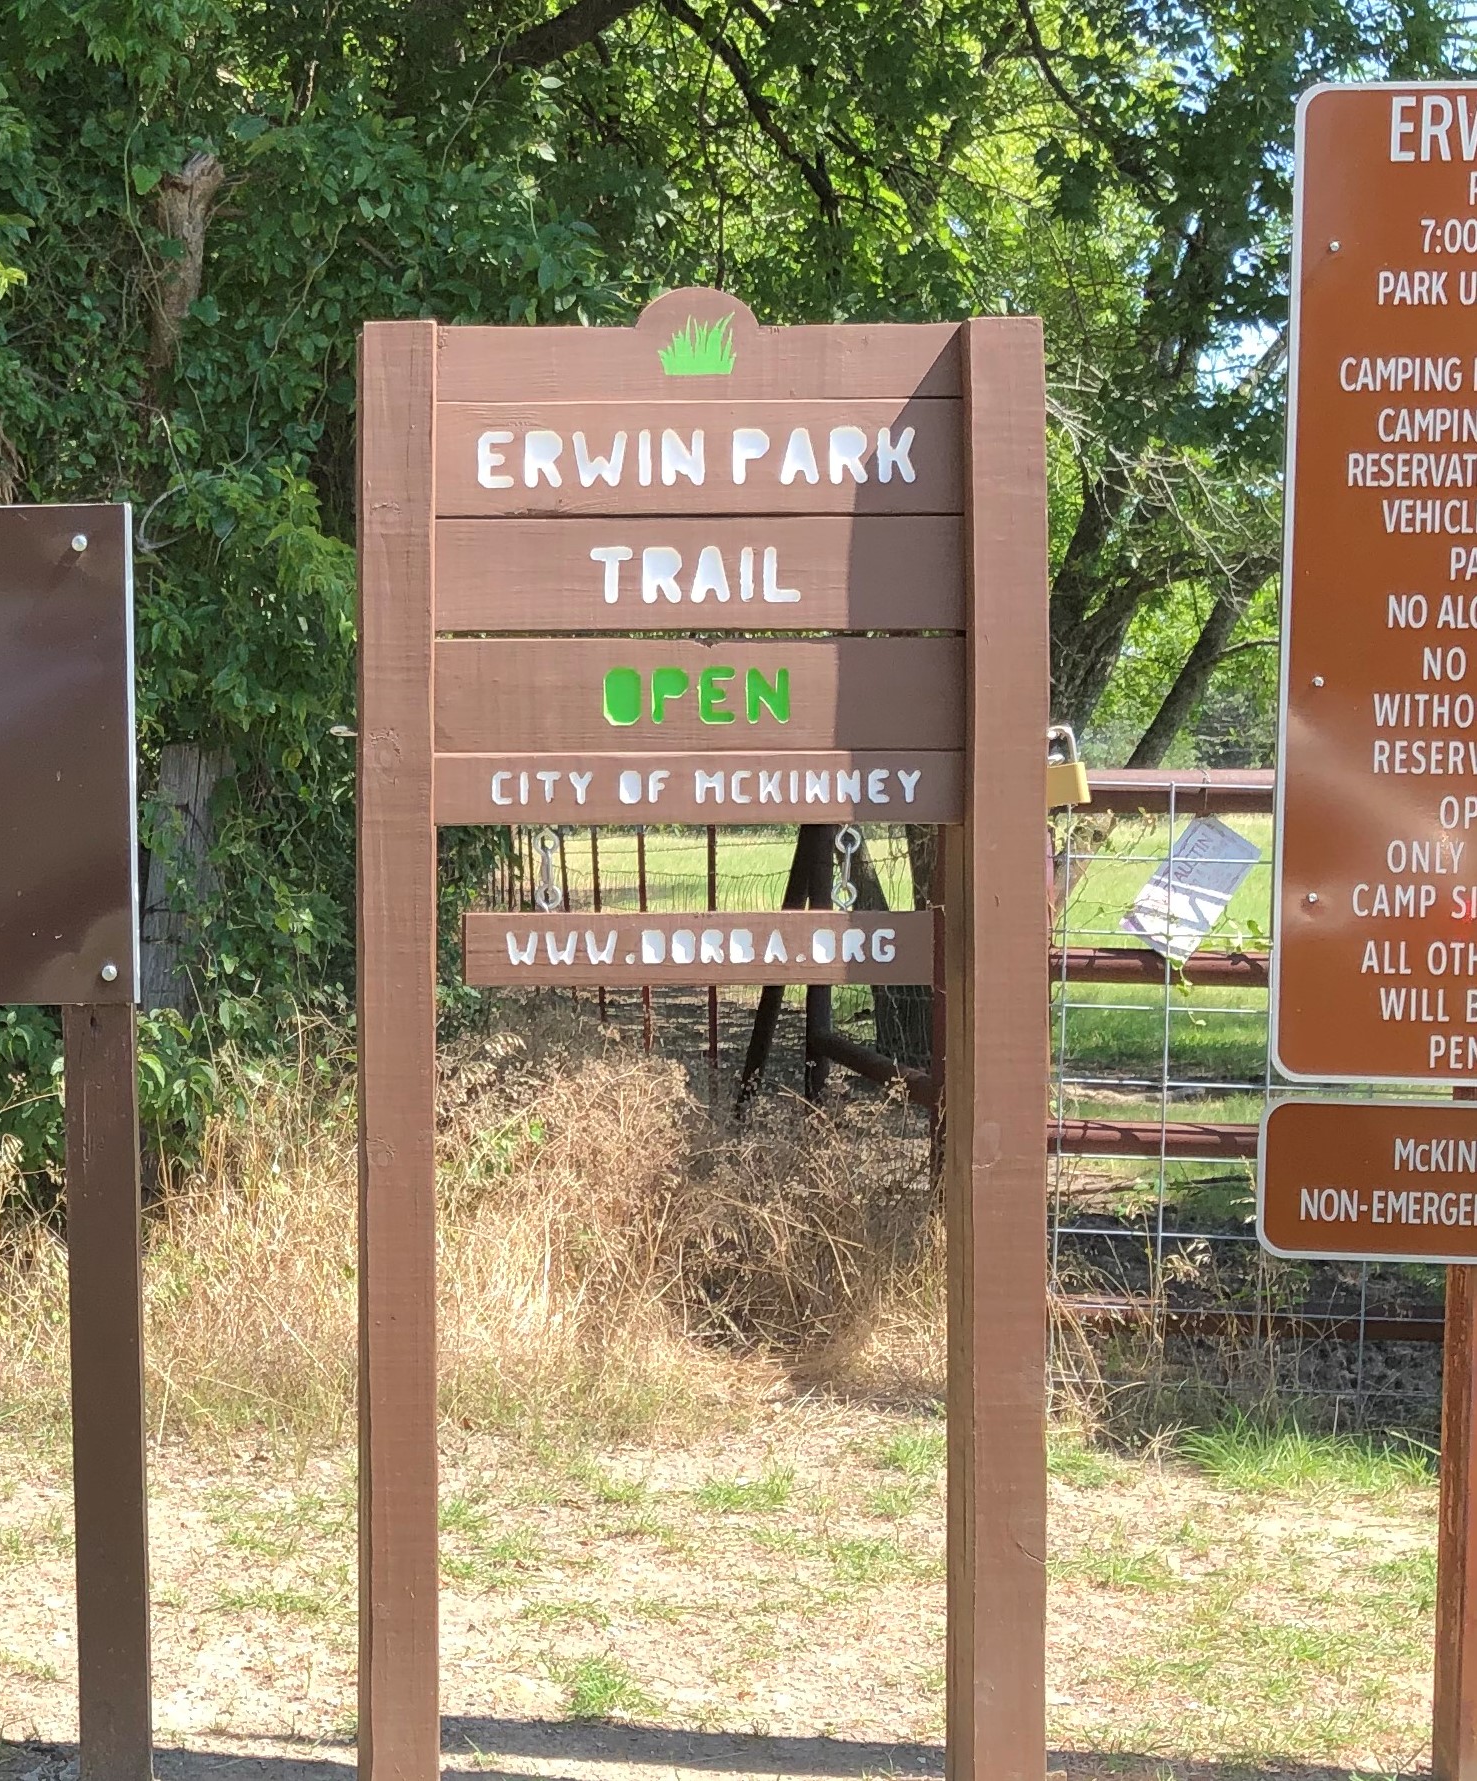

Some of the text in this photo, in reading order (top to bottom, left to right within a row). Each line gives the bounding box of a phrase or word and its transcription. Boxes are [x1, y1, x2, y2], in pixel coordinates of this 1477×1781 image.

[1378, 270, 1448, 306] PARK
[1340, 356, 1463, 392] CAMPING
[477, 425, 916, 489] ERWIN PARK
[1382, 499, 1477, 534] VEHICL
[589, 545, 802, 604] TRAIL
[1387, 594, 1428, 629] NO
[1422, 646, 1467, 682] NO
[602, 666, 791, 726] OPEN
[1373, 693, 1477, 730] WITHO
[491, 768, 922, 806] CITY OF MCKINNEY
[1387, 839, 1465, 874] ONLY
[1352, 883, 1436, 919] CAMP
[505, 928, 896, 967] WWW.DORBA.ORG
[1360, 939, 1412, 975] ALL
[1379, 987, 1450, 1022] WILL
[1300, 1188, 1477, 1227] NON-EMERGE
